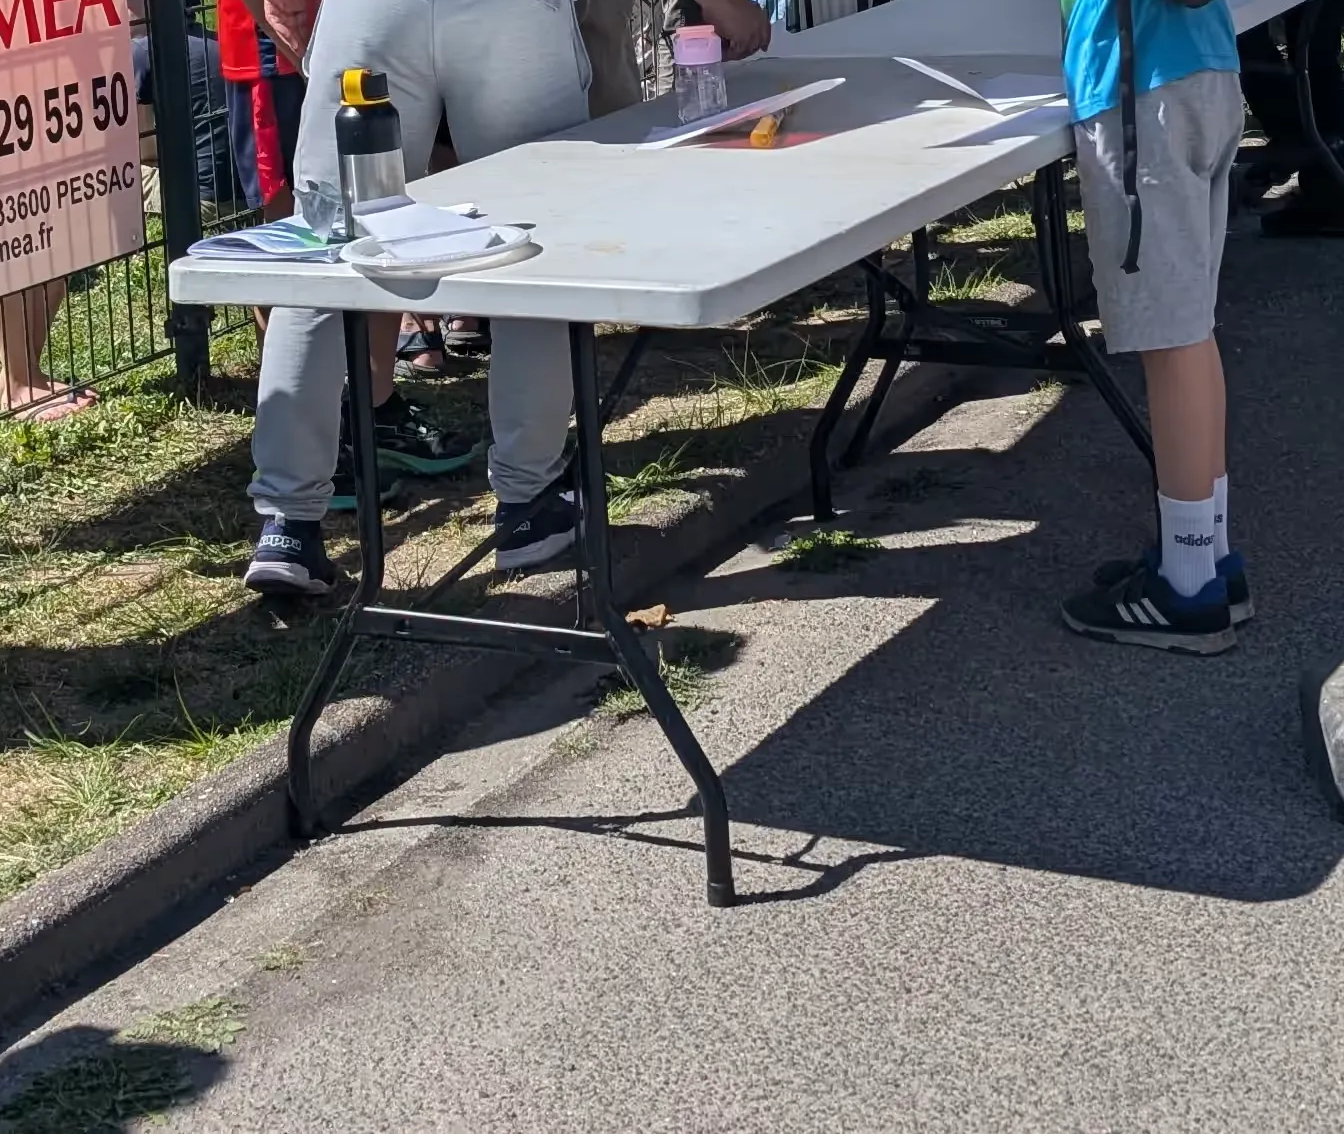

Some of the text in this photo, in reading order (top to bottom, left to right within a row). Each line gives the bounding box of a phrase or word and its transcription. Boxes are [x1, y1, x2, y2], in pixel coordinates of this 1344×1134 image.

[43, 82, 83, 144] 55
[91, 71, 129, 132] 50
[56, 161, 135, 210] PESSAC
[1173, 533, 1215, 547] adida
